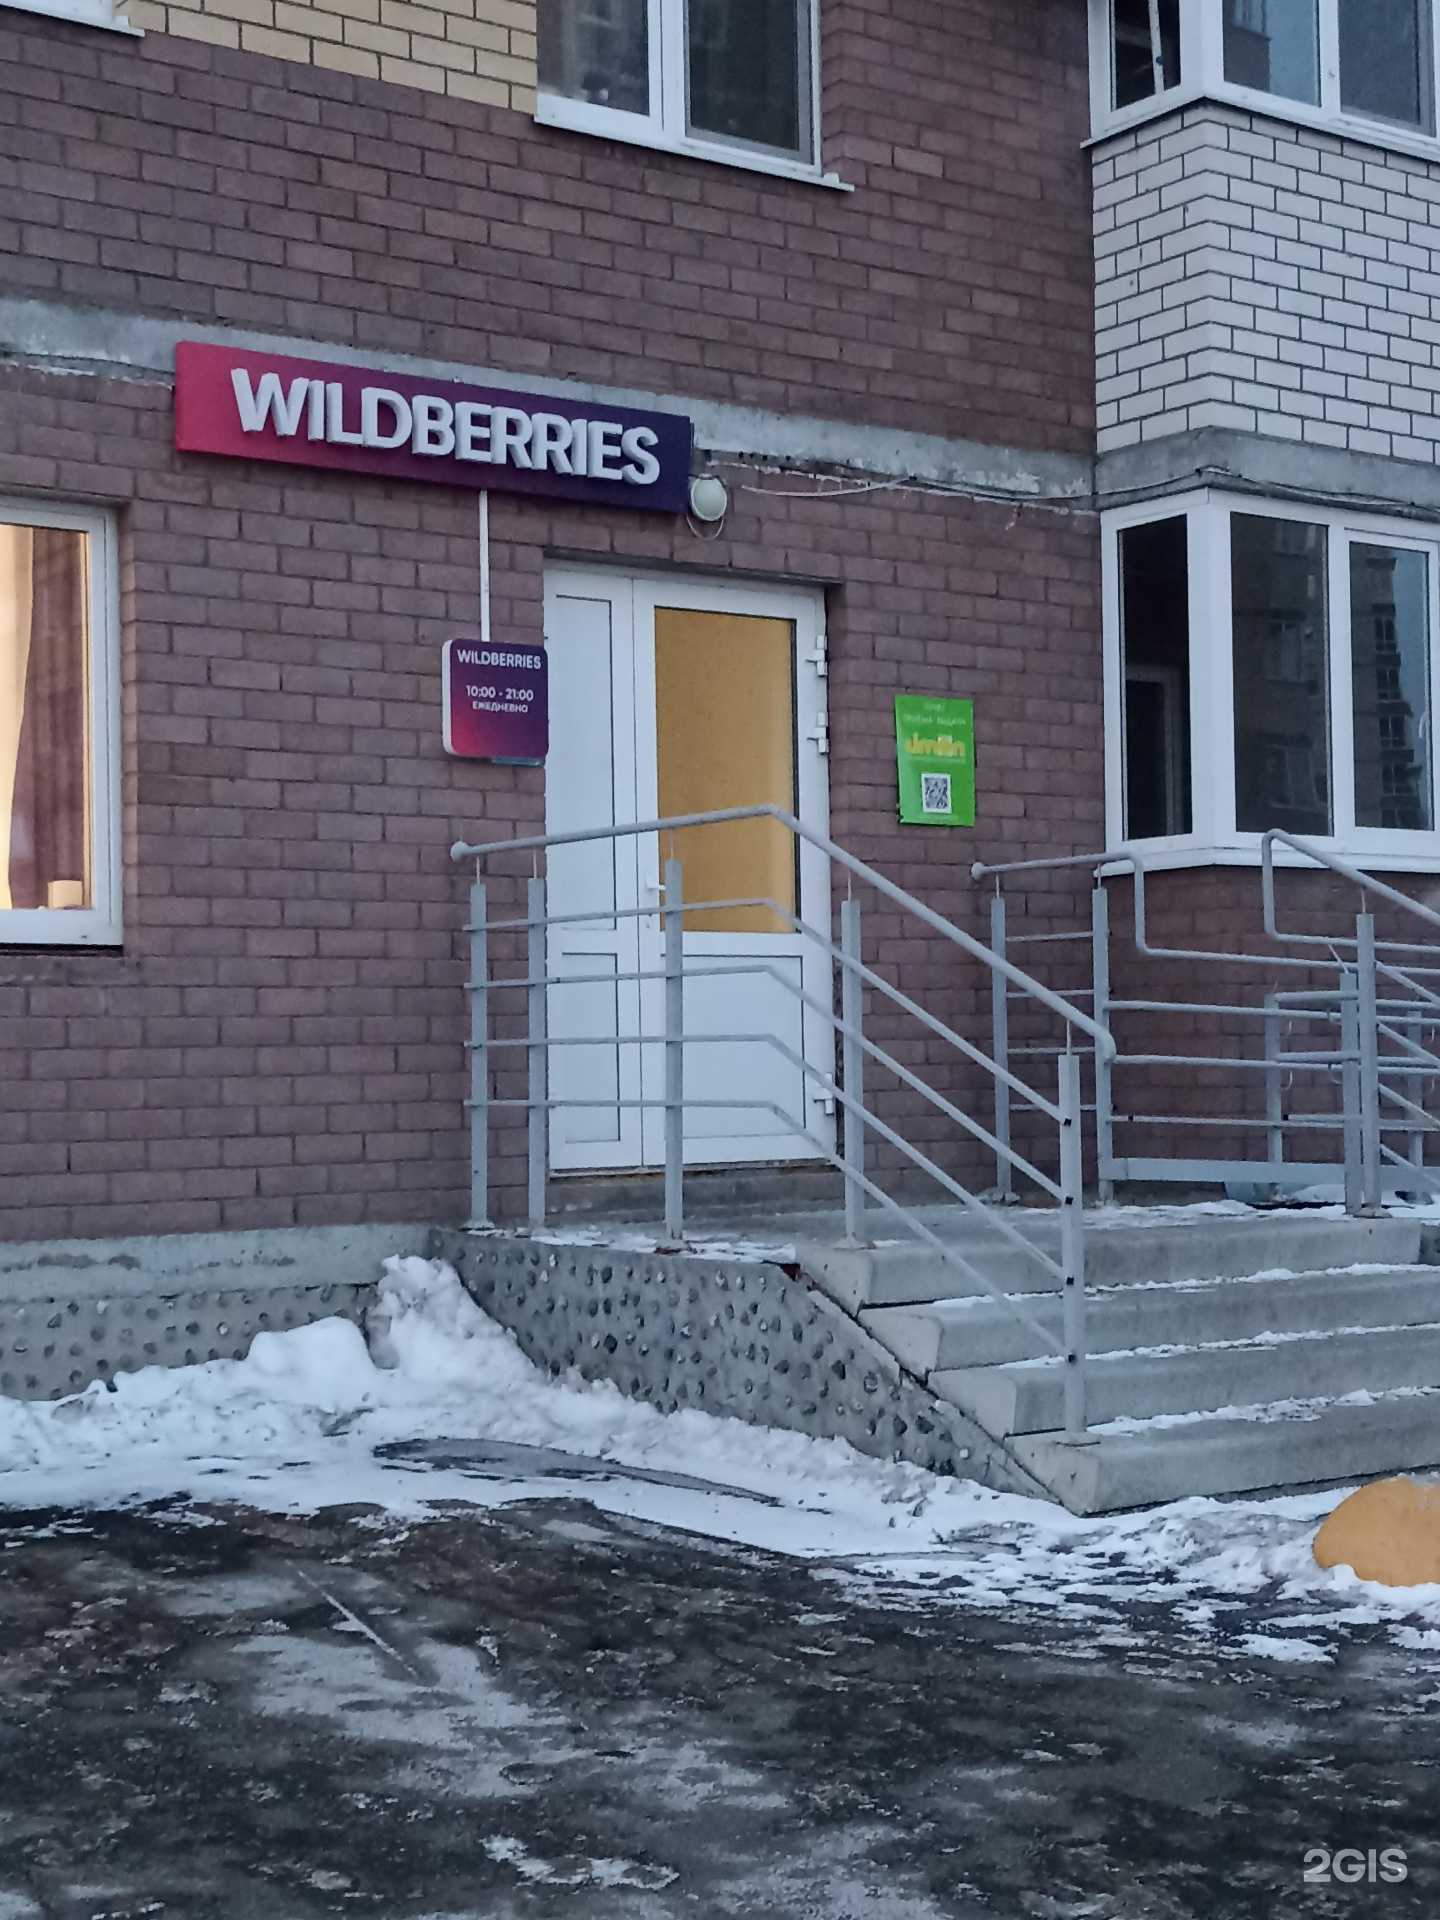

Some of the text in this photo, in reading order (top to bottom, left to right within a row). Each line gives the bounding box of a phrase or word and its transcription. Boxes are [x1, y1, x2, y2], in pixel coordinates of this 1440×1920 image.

[231, 368, 661, 486] WILDBERRIES
[457, 649, 542, 669] WILDBERRIES
[466, 685, 496, 698] 10:00
[505, 688, 534, 701] 21:00
